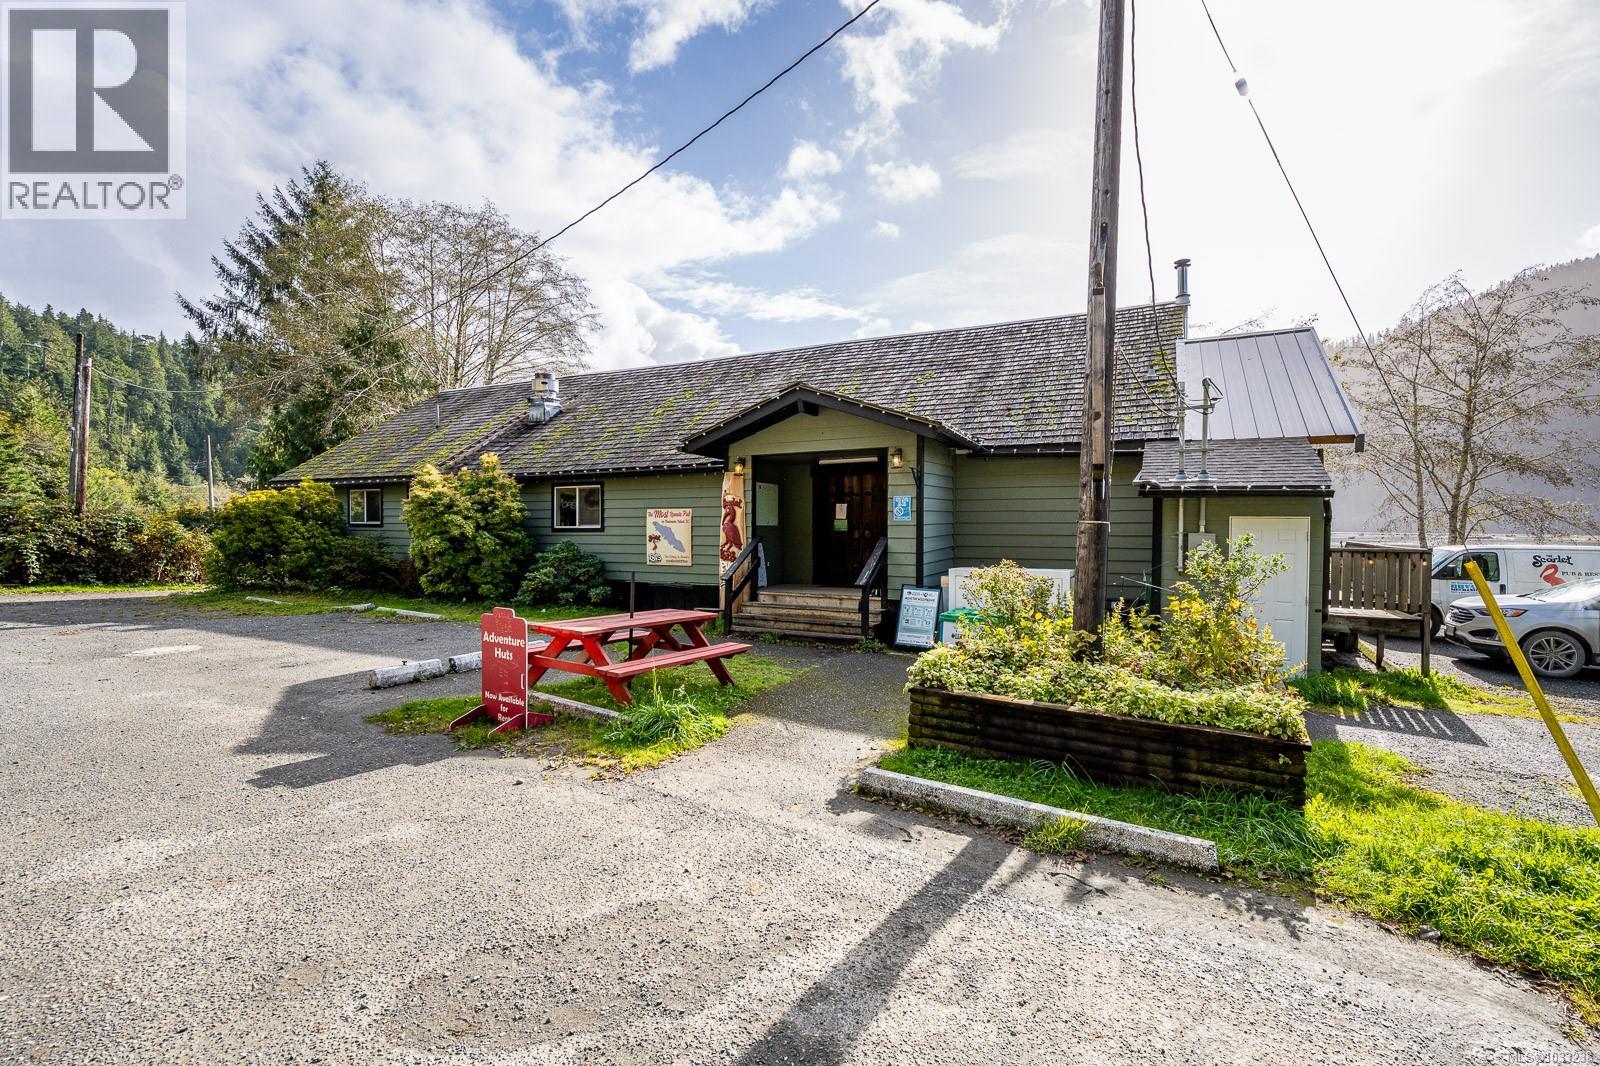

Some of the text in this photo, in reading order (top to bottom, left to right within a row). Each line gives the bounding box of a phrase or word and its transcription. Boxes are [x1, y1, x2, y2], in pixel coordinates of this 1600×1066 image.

[654, 510, 669, 518] Most
[1532, 555, 1573, 567] Scarlet
[483, 631, 525, 647] Adventure
[495, 647, 513, 660] Huts
[485, 690, 525, 707] Now Available
